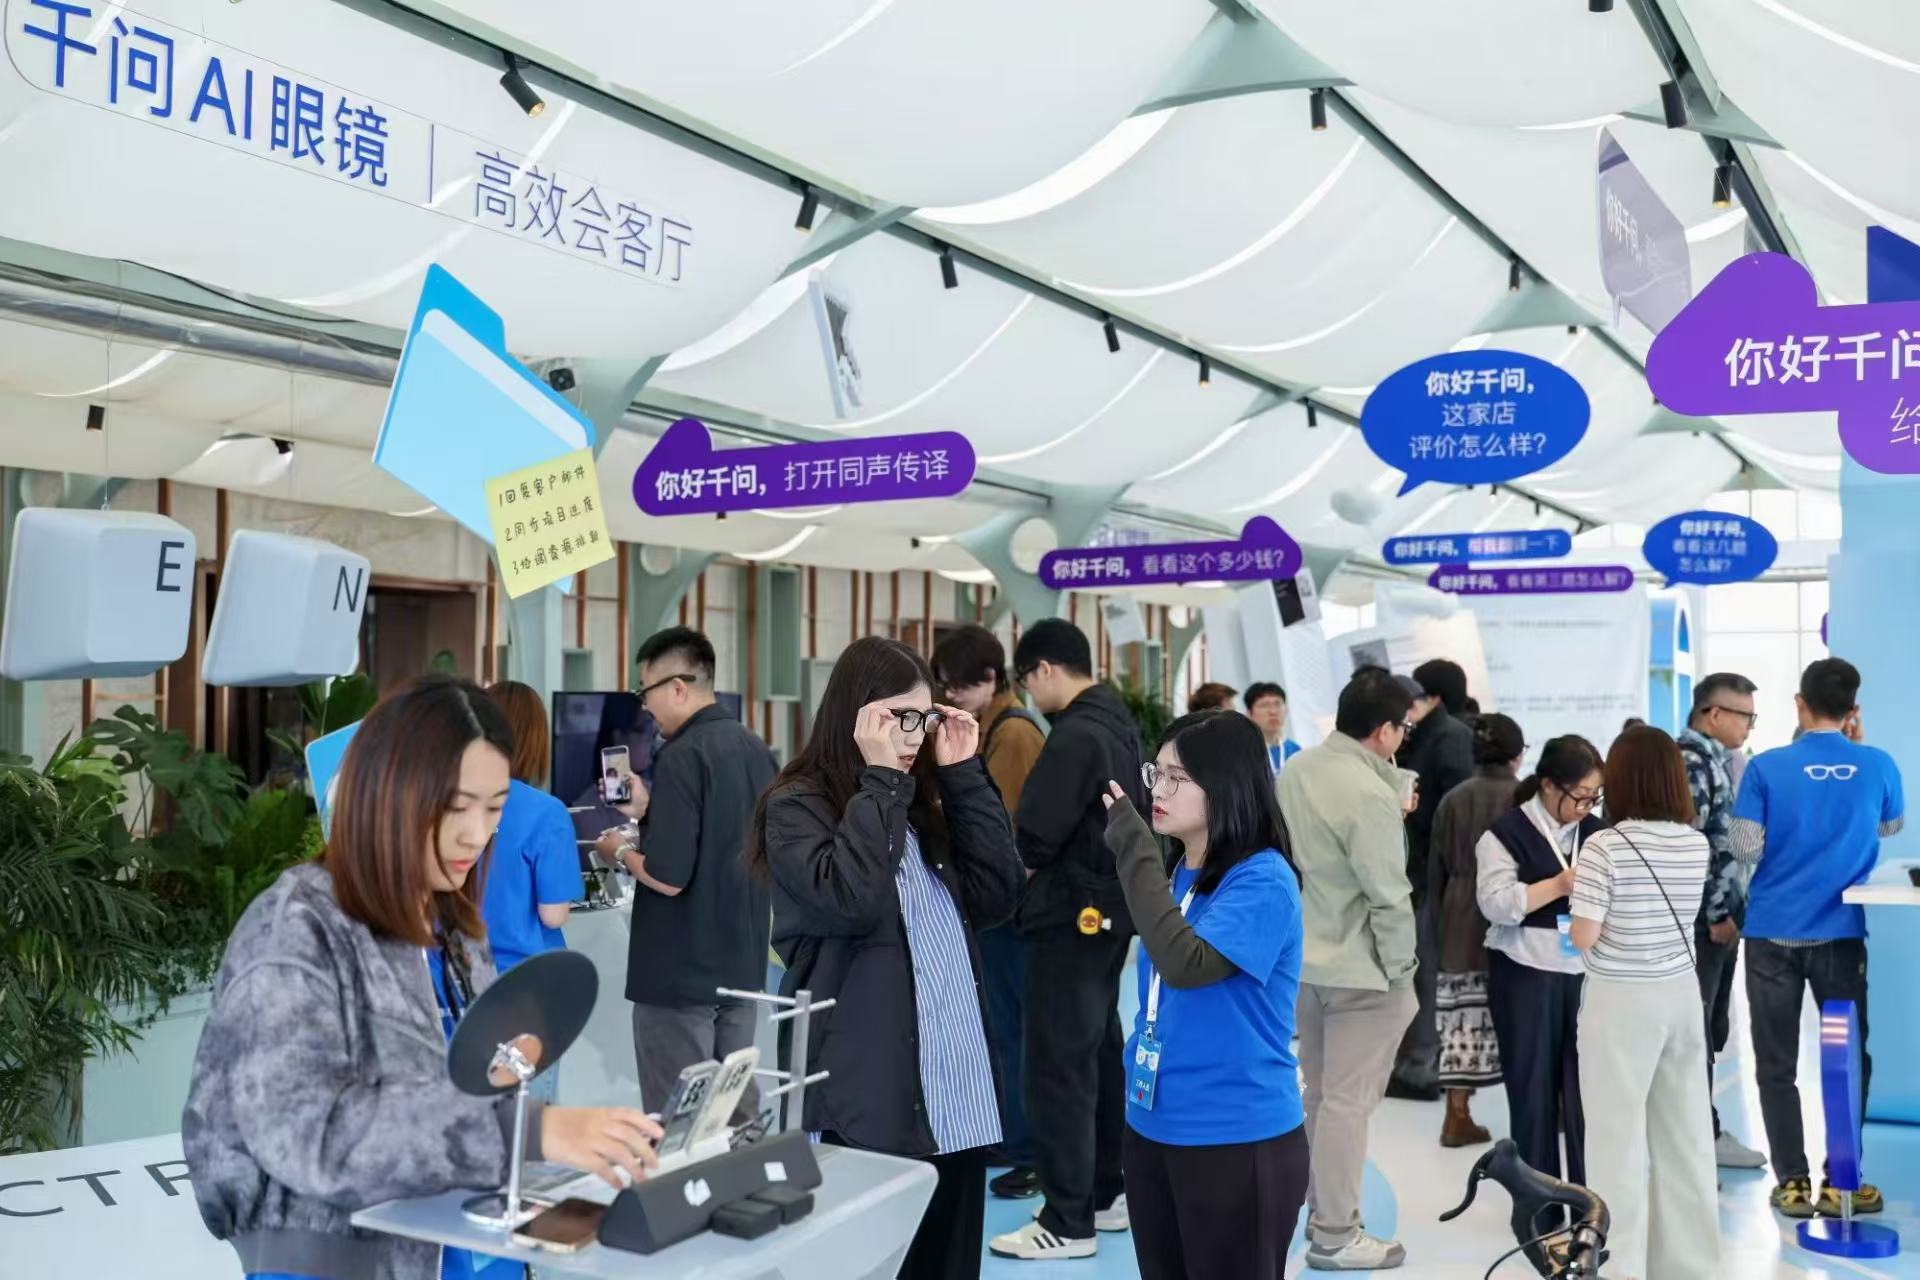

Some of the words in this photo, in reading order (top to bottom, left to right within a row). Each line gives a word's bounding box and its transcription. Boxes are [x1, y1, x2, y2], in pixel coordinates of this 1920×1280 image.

[24, 0, 389, 187] 千问AI眼镜
[476, 151, 692, 281] 高效会客厅
[1425, 368, 1535, 397] 你好千问，
[1442, 401, 1517, 427] 这家店
[1409, 432, 1547, 460] 评价怎么样？
[655, 450, 950, 501] 你好千问，打开同声传译
[156, 541, 185, 592] E
[333, 565, 363, 613] N
